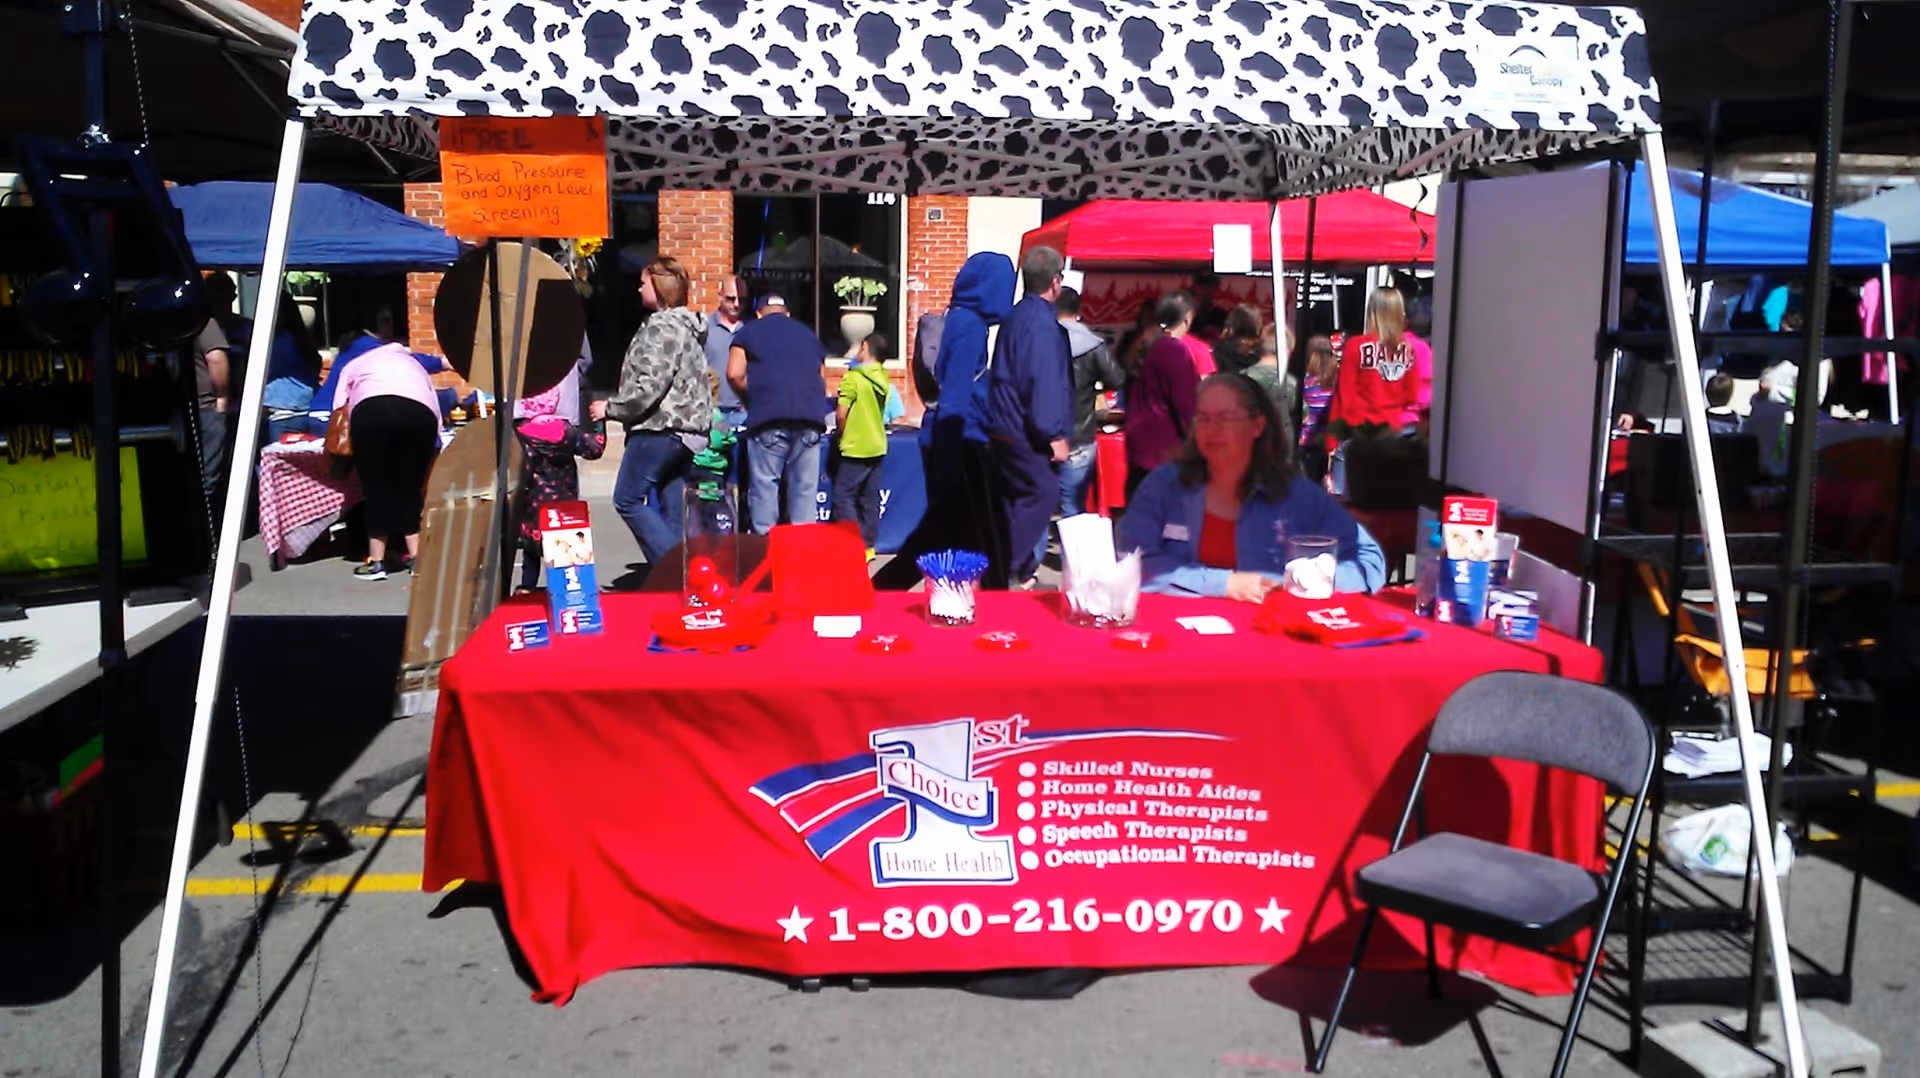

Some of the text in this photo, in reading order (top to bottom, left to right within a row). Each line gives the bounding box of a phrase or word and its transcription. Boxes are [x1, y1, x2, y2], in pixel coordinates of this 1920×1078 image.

[1500, 63, 1532, 74] Shelter
[1530, 76, 1562, 87] Canopy
[452, 161, 586, 186] Blood Pressure
[461, 183, 593, 201] and Oxygen Level
[867, 192, 896, 205] 114
[1042, 760, 1214, 780] Skilled Nurses
[888, 760, 980, 811] Choice
[1041, 779, 1262, 802] Home Health Aides
[1040, 800, 1268, 823] Physical Therapists
[1041, 821, 1248, 846] Speech Therapists
[885, 851, 1006, 873] Home Health
[1044, 844, 1316, 870] Occupational Therapists
[828, 897, 1244, 942] 1-800-216-0970
